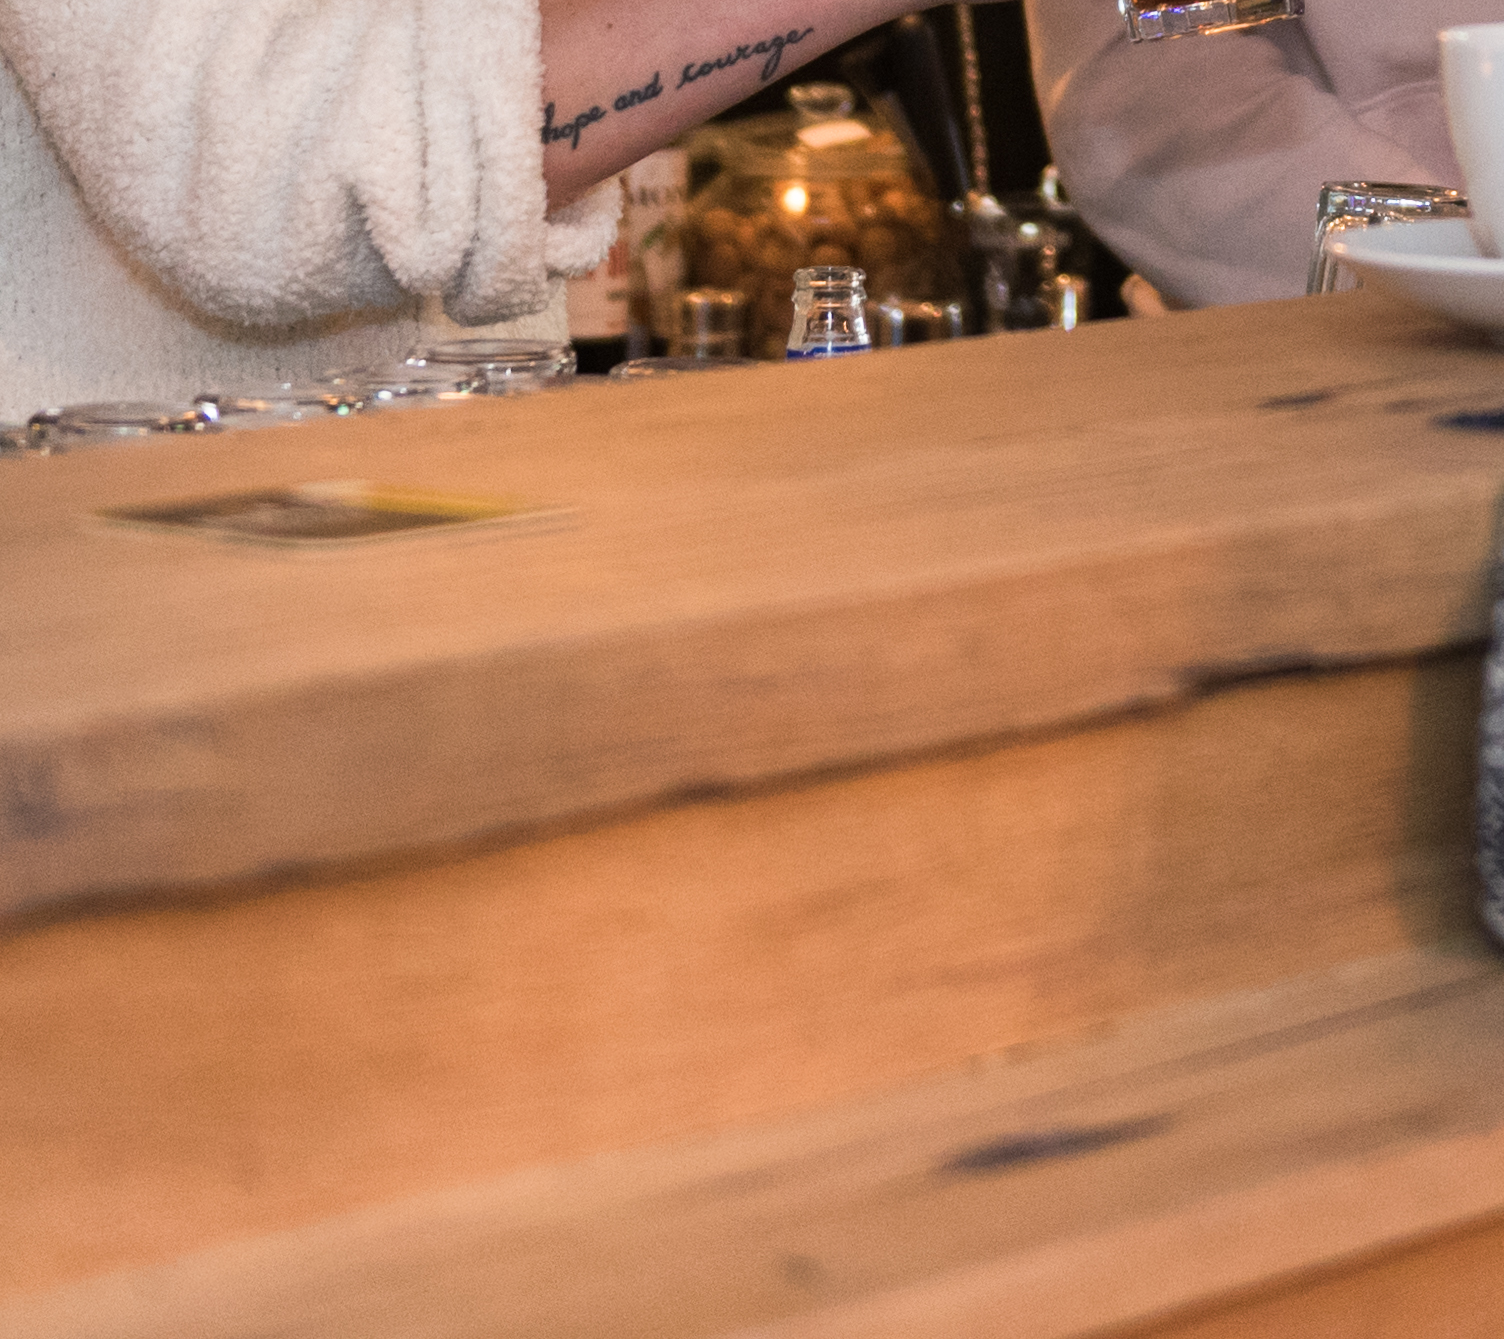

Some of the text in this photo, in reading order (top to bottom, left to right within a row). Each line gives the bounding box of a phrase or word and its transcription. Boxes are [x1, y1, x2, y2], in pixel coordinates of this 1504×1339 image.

[541, 27, 815, 150] hope and courage
